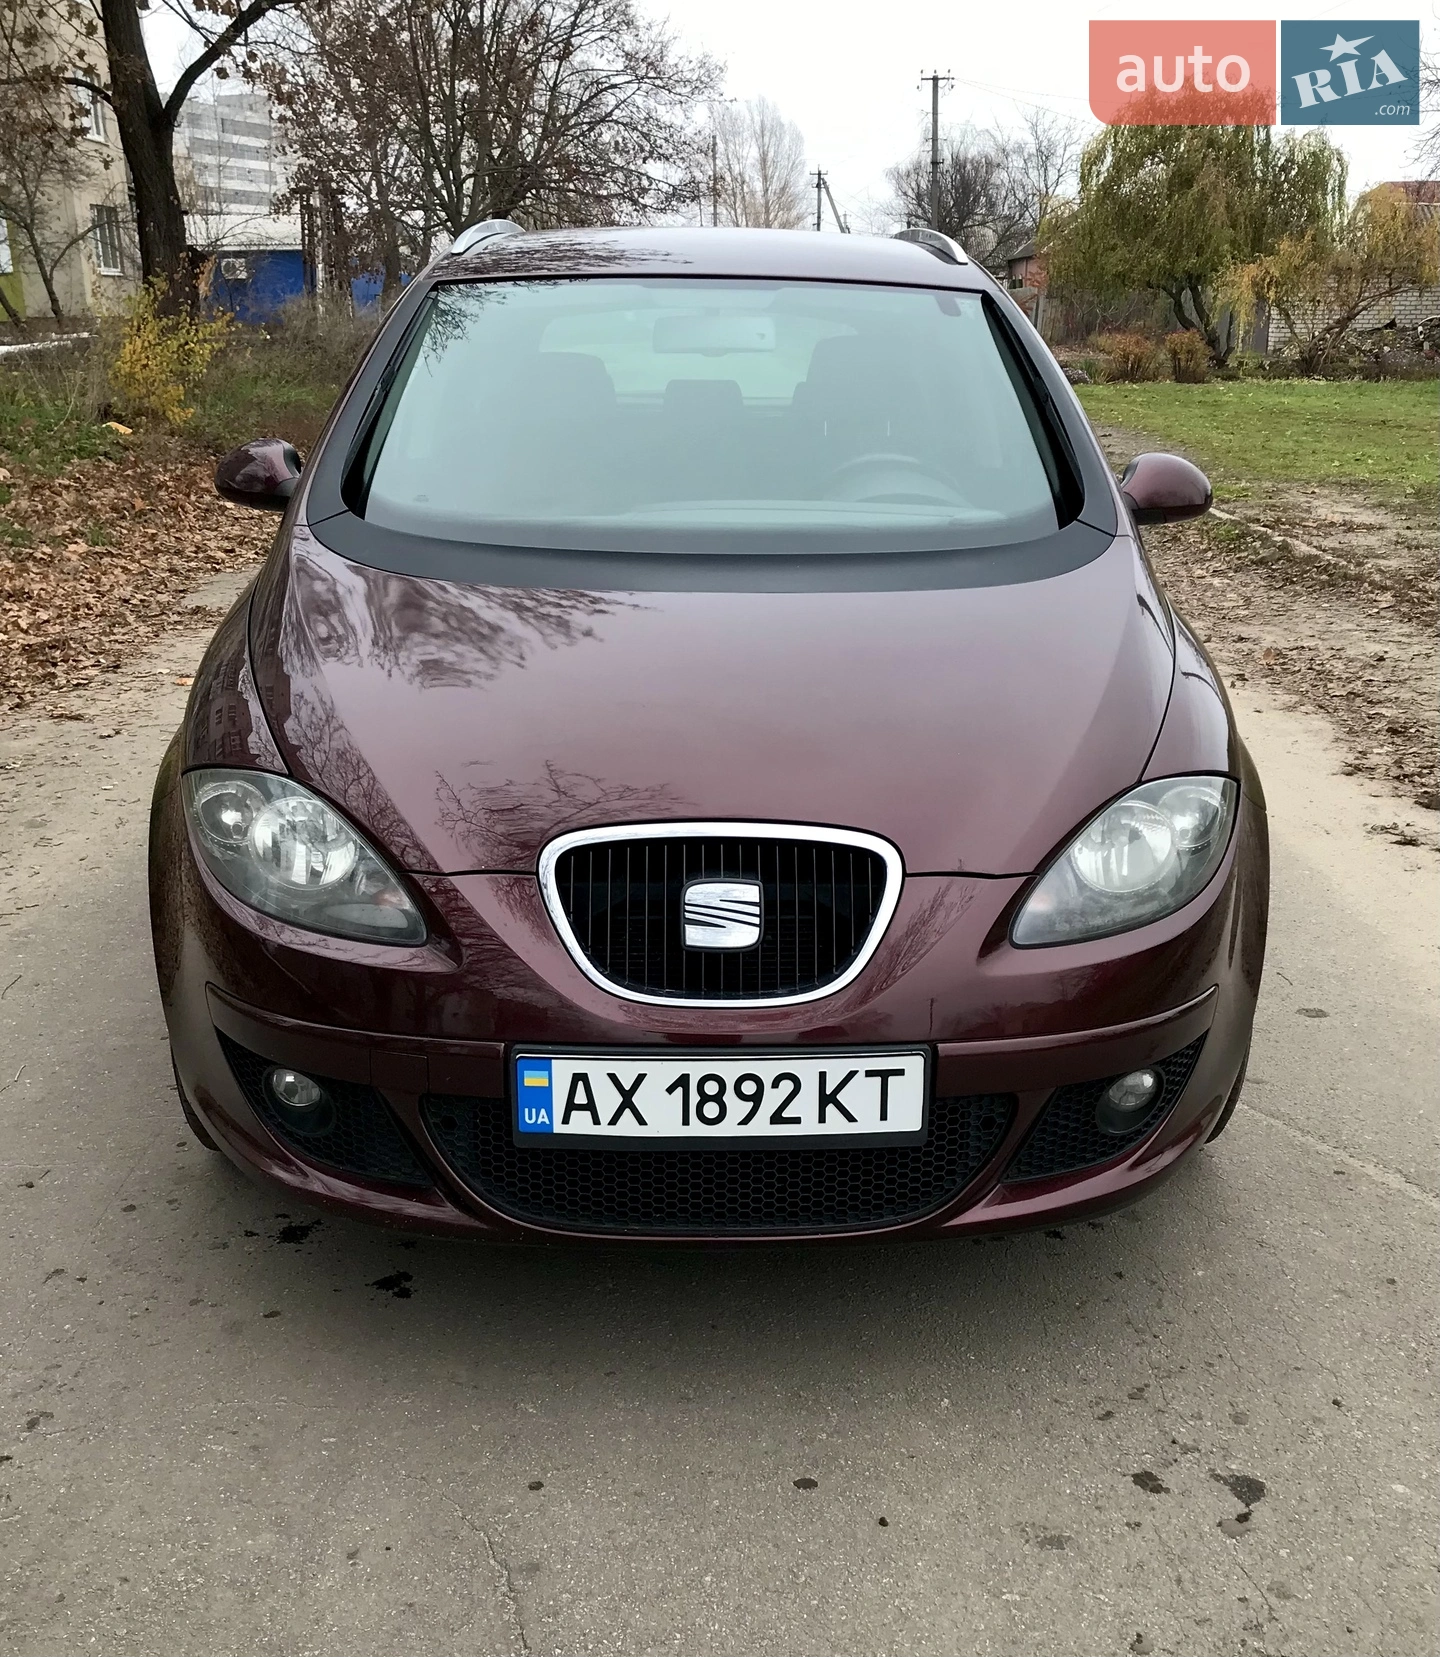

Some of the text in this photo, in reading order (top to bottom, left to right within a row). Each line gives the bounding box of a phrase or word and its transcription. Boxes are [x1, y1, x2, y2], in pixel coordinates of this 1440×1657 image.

[560, 1068, 906, 1126] AX 1892 KT
[523, 1108, 550, 1125] UA
